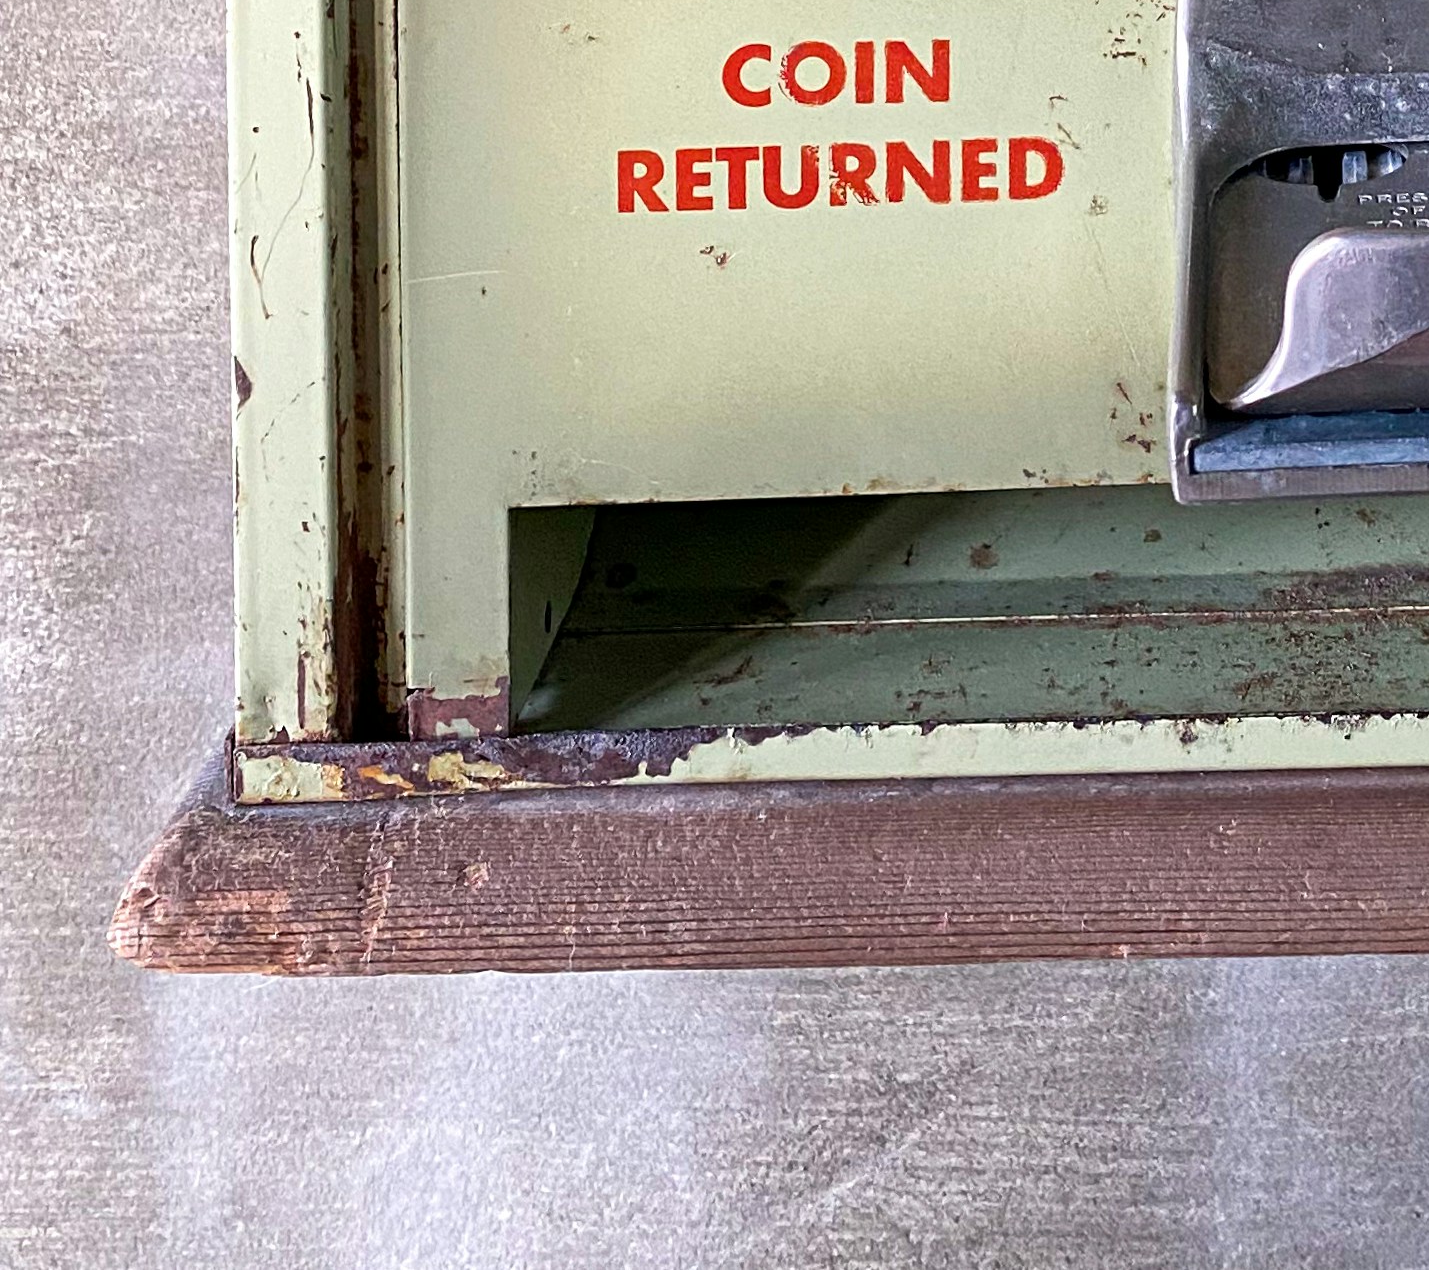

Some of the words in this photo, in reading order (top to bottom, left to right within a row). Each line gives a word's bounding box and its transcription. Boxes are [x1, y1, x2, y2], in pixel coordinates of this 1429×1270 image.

[722, 39, 951, 108] COIN
[617, 136, 1066, 213] RETURNED
[1392, 205, 1426, 216] OF
